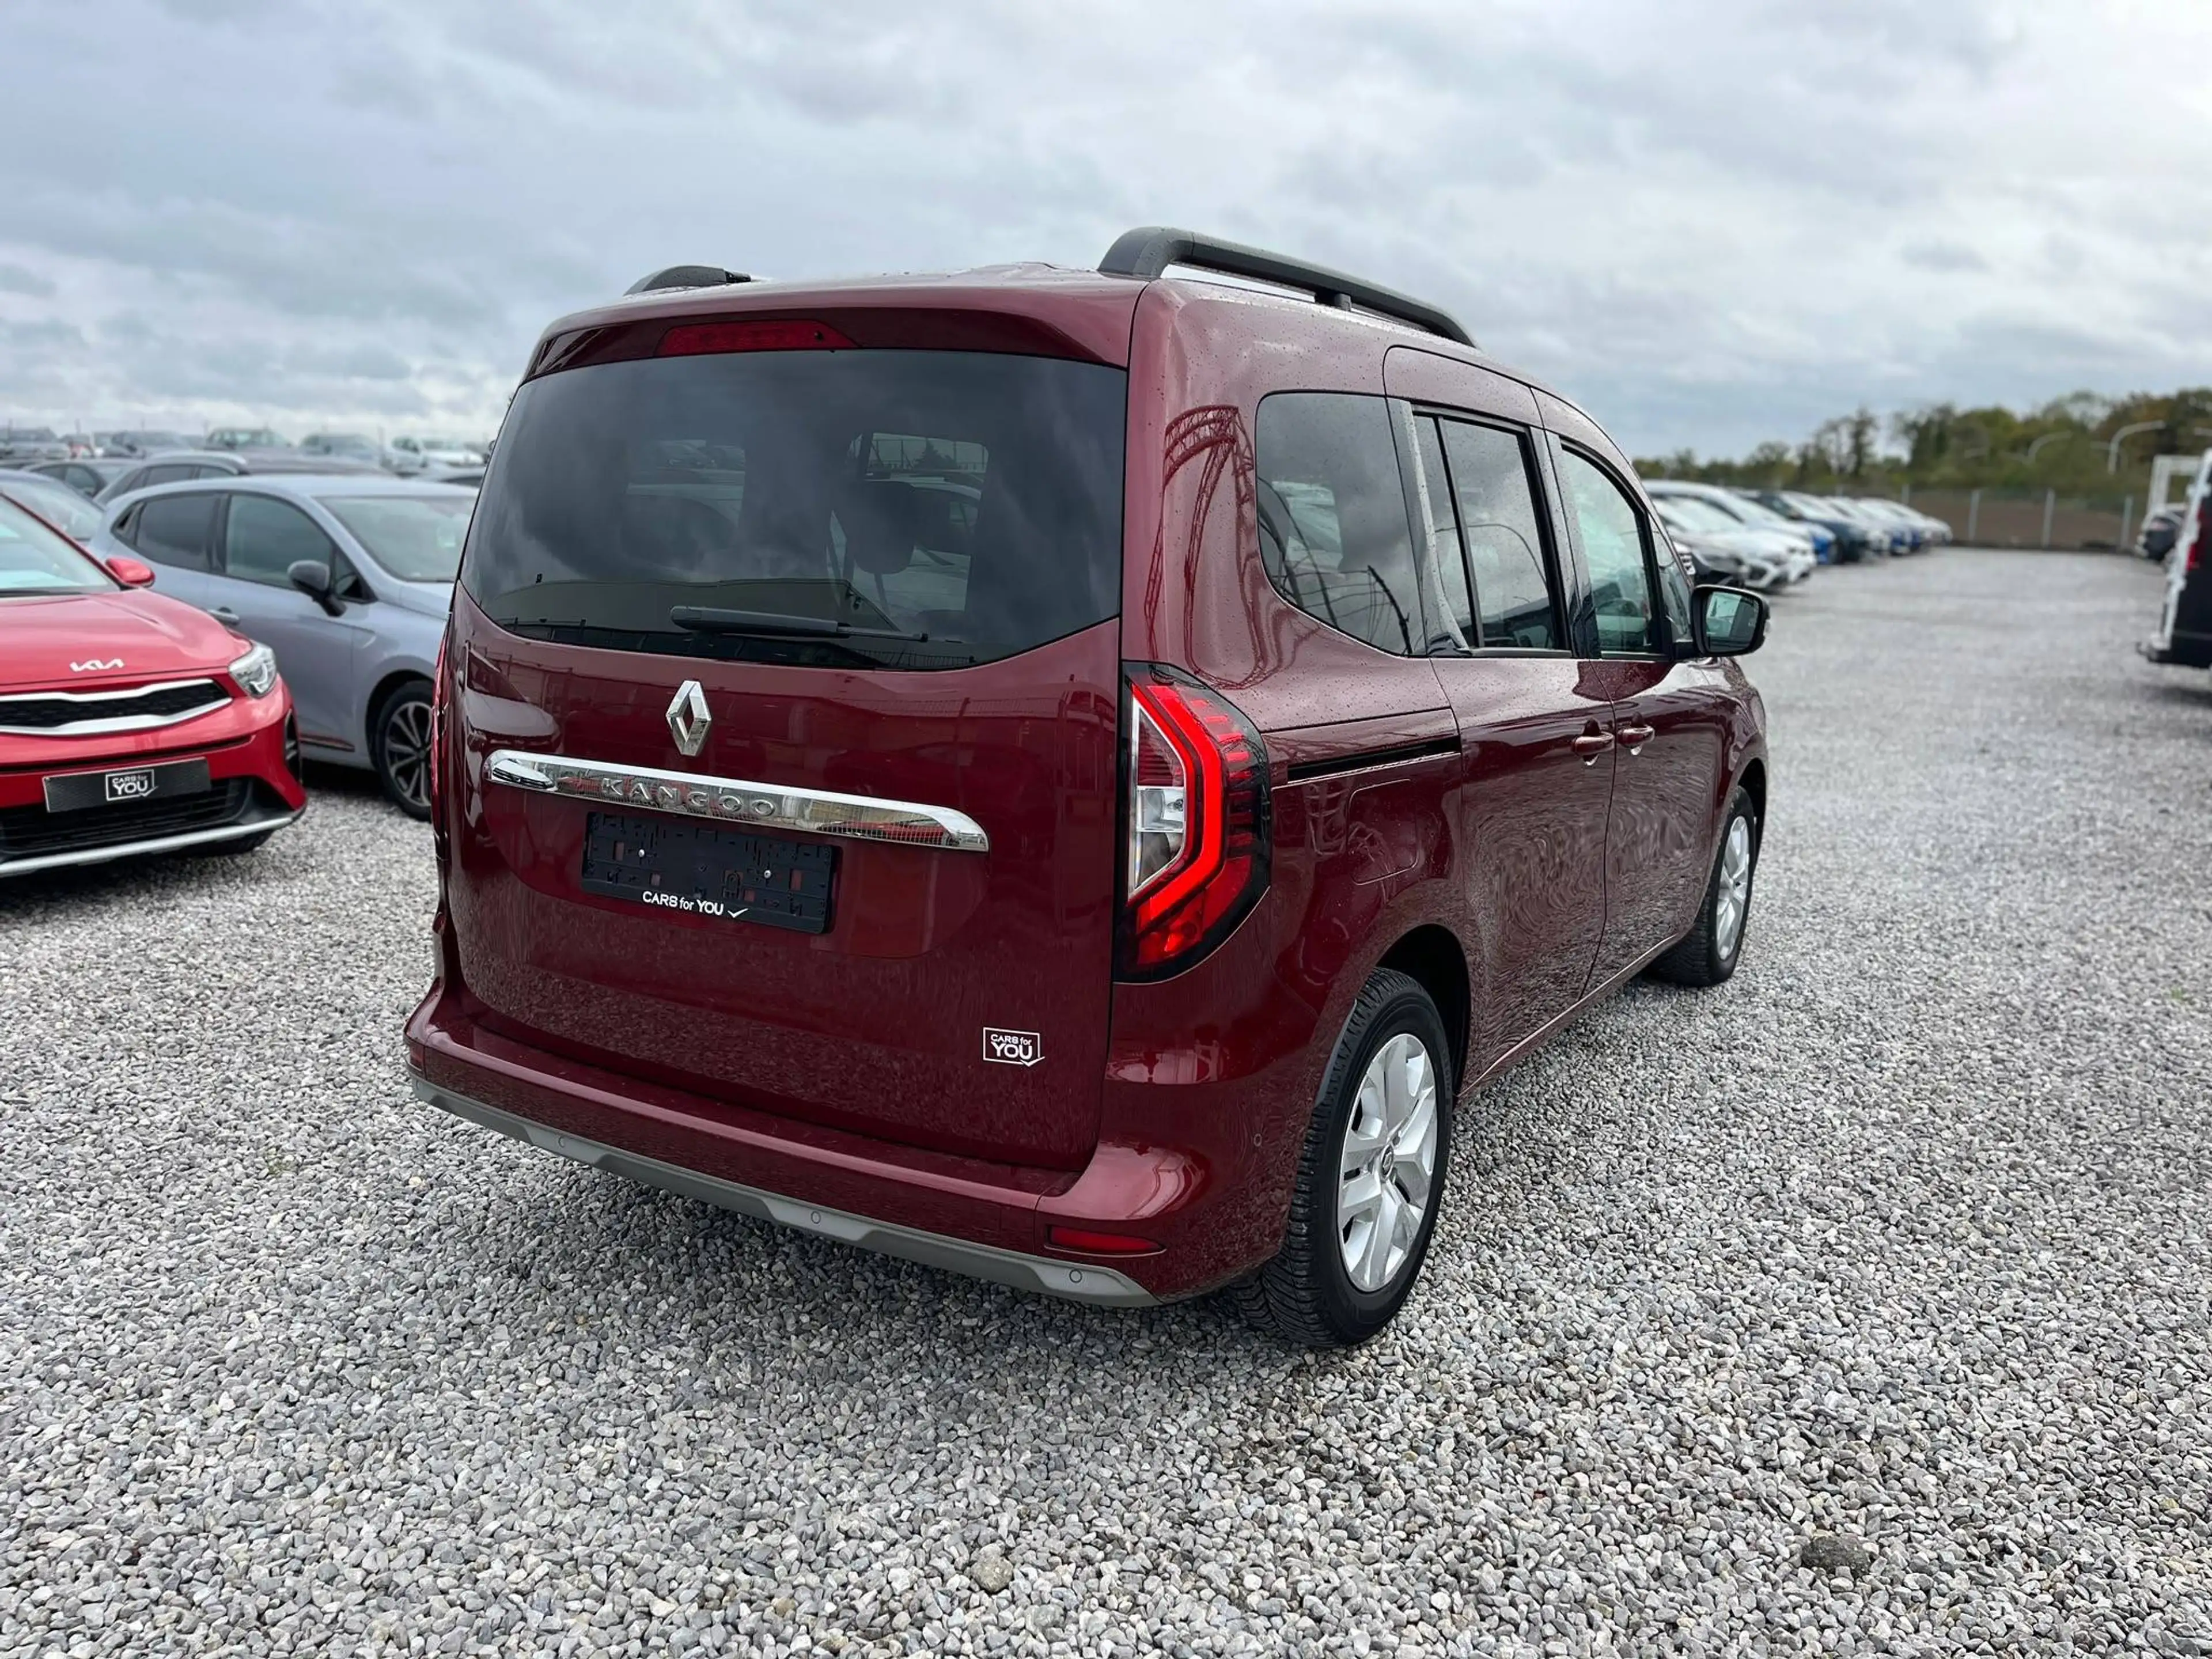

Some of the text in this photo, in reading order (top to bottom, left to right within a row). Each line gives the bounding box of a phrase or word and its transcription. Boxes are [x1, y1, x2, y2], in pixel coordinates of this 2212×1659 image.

[69, 658, 124, 672] KIA
[112, 775, 137, 783] CARS
[113, 779, 148, 795] YOU
[601, 778, 775, 816] KANGOO
[642, 891, 724, 915] CARS for YOU
[990, 1033, 1032, 1045] CARS for
[990, 1041, 1032, 1059] YOU
